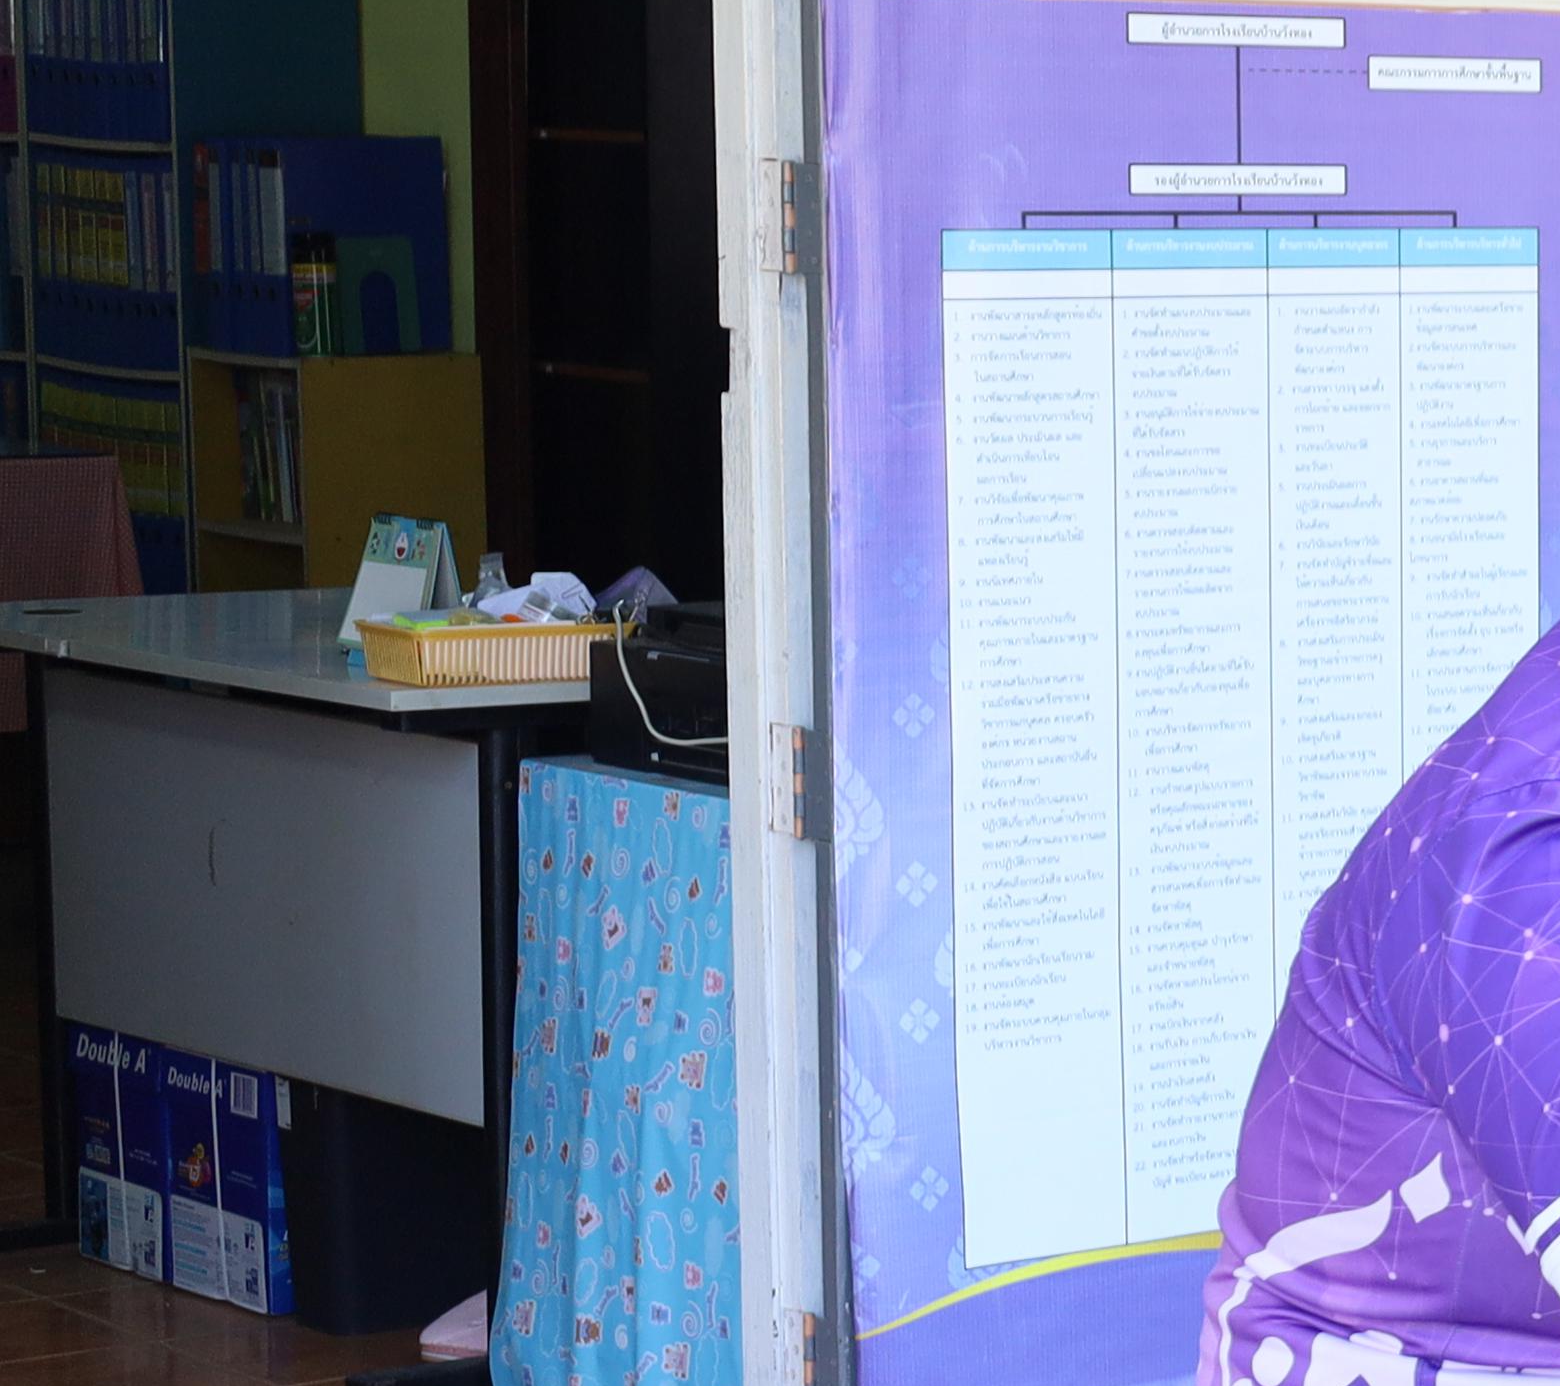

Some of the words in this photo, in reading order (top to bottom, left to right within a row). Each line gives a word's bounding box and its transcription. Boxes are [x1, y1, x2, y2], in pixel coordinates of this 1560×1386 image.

[76, 1033, 131, 1070] Double
[134, 1048, 147, 1075] A
[167, 1066, 211, 1095] Double
